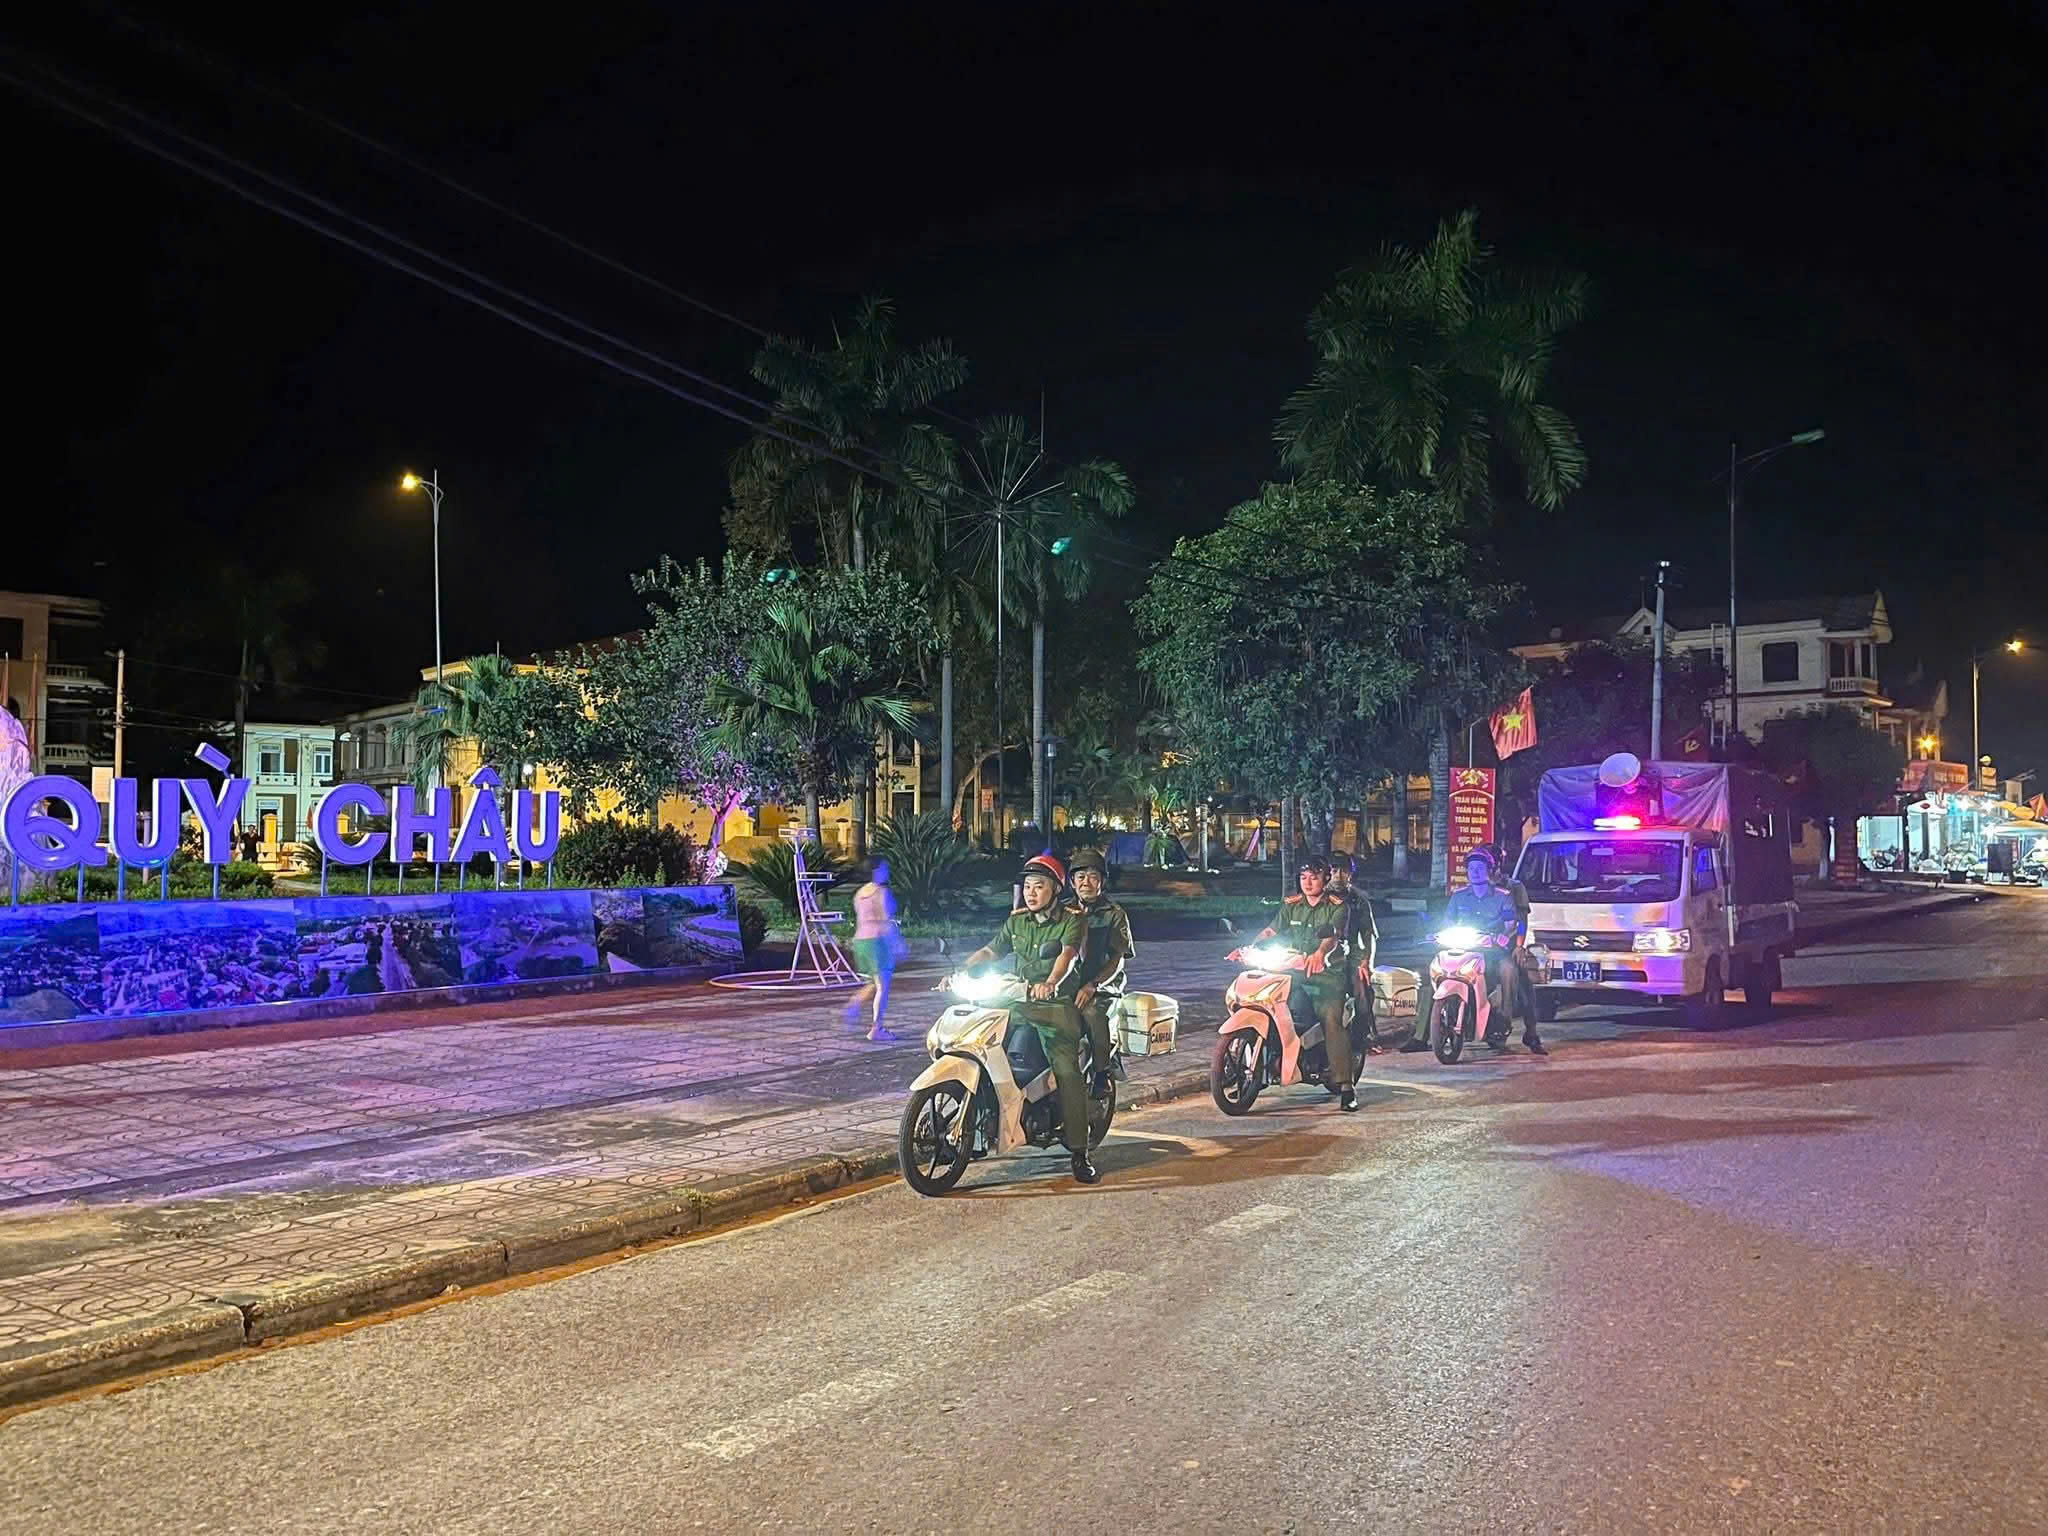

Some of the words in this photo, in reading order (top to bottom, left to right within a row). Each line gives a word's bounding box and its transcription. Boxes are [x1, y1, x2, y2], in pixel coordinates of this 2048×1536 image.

[2, 742, 251, 870] QUỲ
[314, 766, 560, 864] CHÂU
[1573, 962, 1591, 971] 37A
